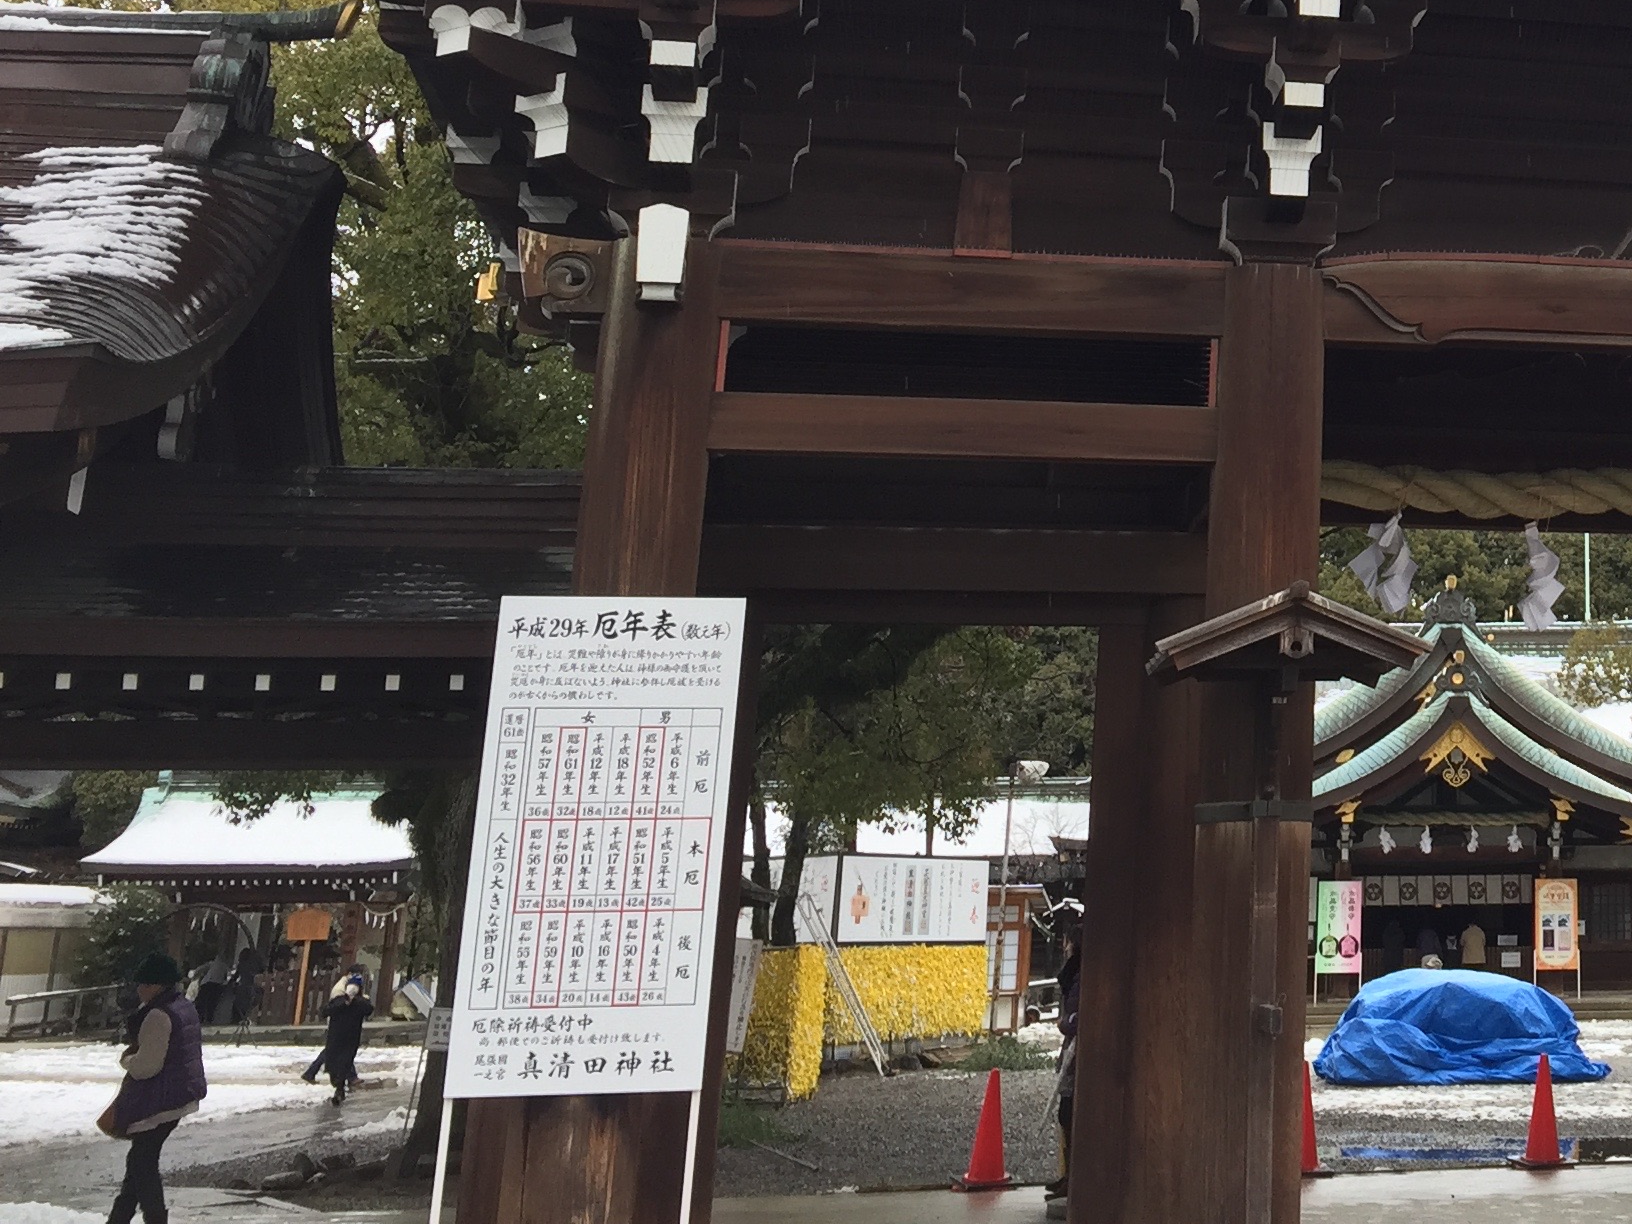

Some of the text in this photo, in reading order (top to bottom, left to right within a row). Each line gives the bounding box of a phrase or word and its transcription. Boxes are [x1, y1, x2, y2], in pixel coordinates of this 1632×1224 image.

[581, 710, 596, 724] 女
[658, 710, 671, 724] 男
[517, 1049, 675, 1080] 真清田神社
